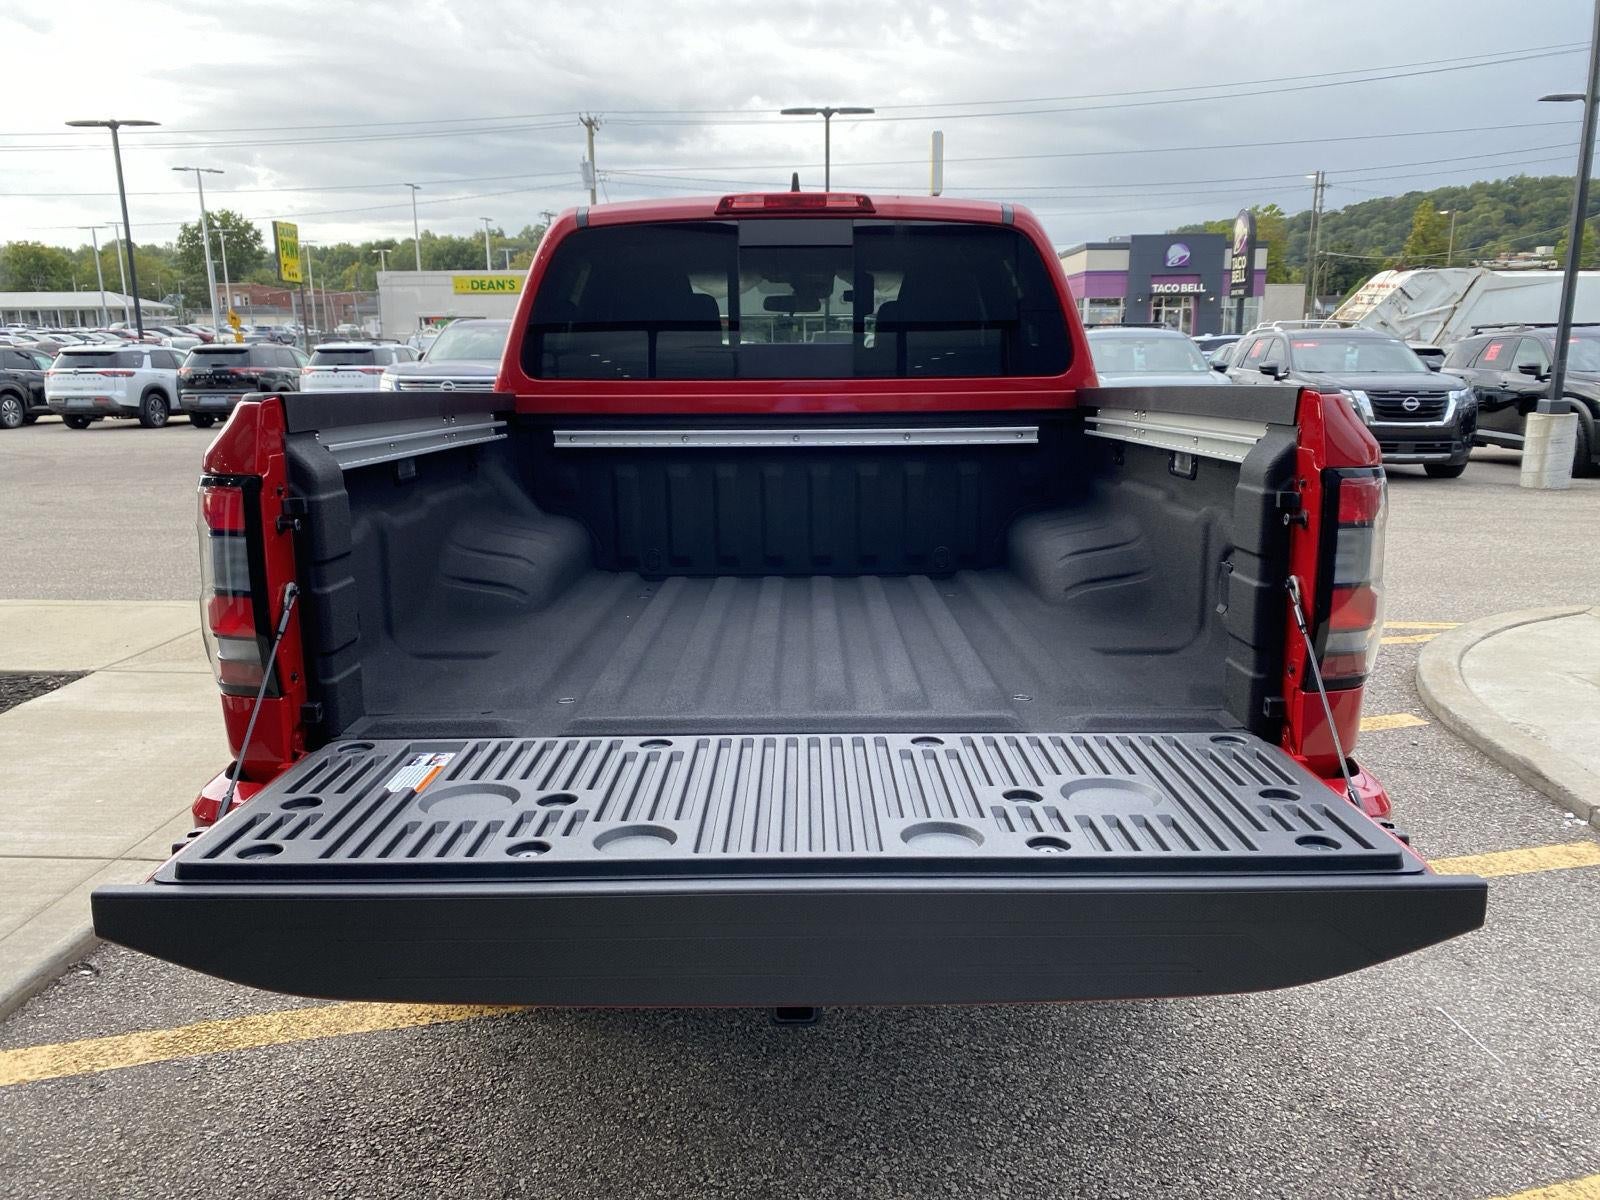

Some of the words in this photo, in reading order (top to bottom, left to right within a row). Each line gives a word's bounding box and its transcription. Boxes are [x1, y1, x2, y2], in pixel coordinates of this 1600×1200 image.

[1232, 256, 1247, 270] TACO
[1231, 270, 1246, 283] BELL
[470, 279, 516, 290] DEAN'S
[1152, 283, 1180, 293] TACO
[1181, 283, 1206, 293] BELL
